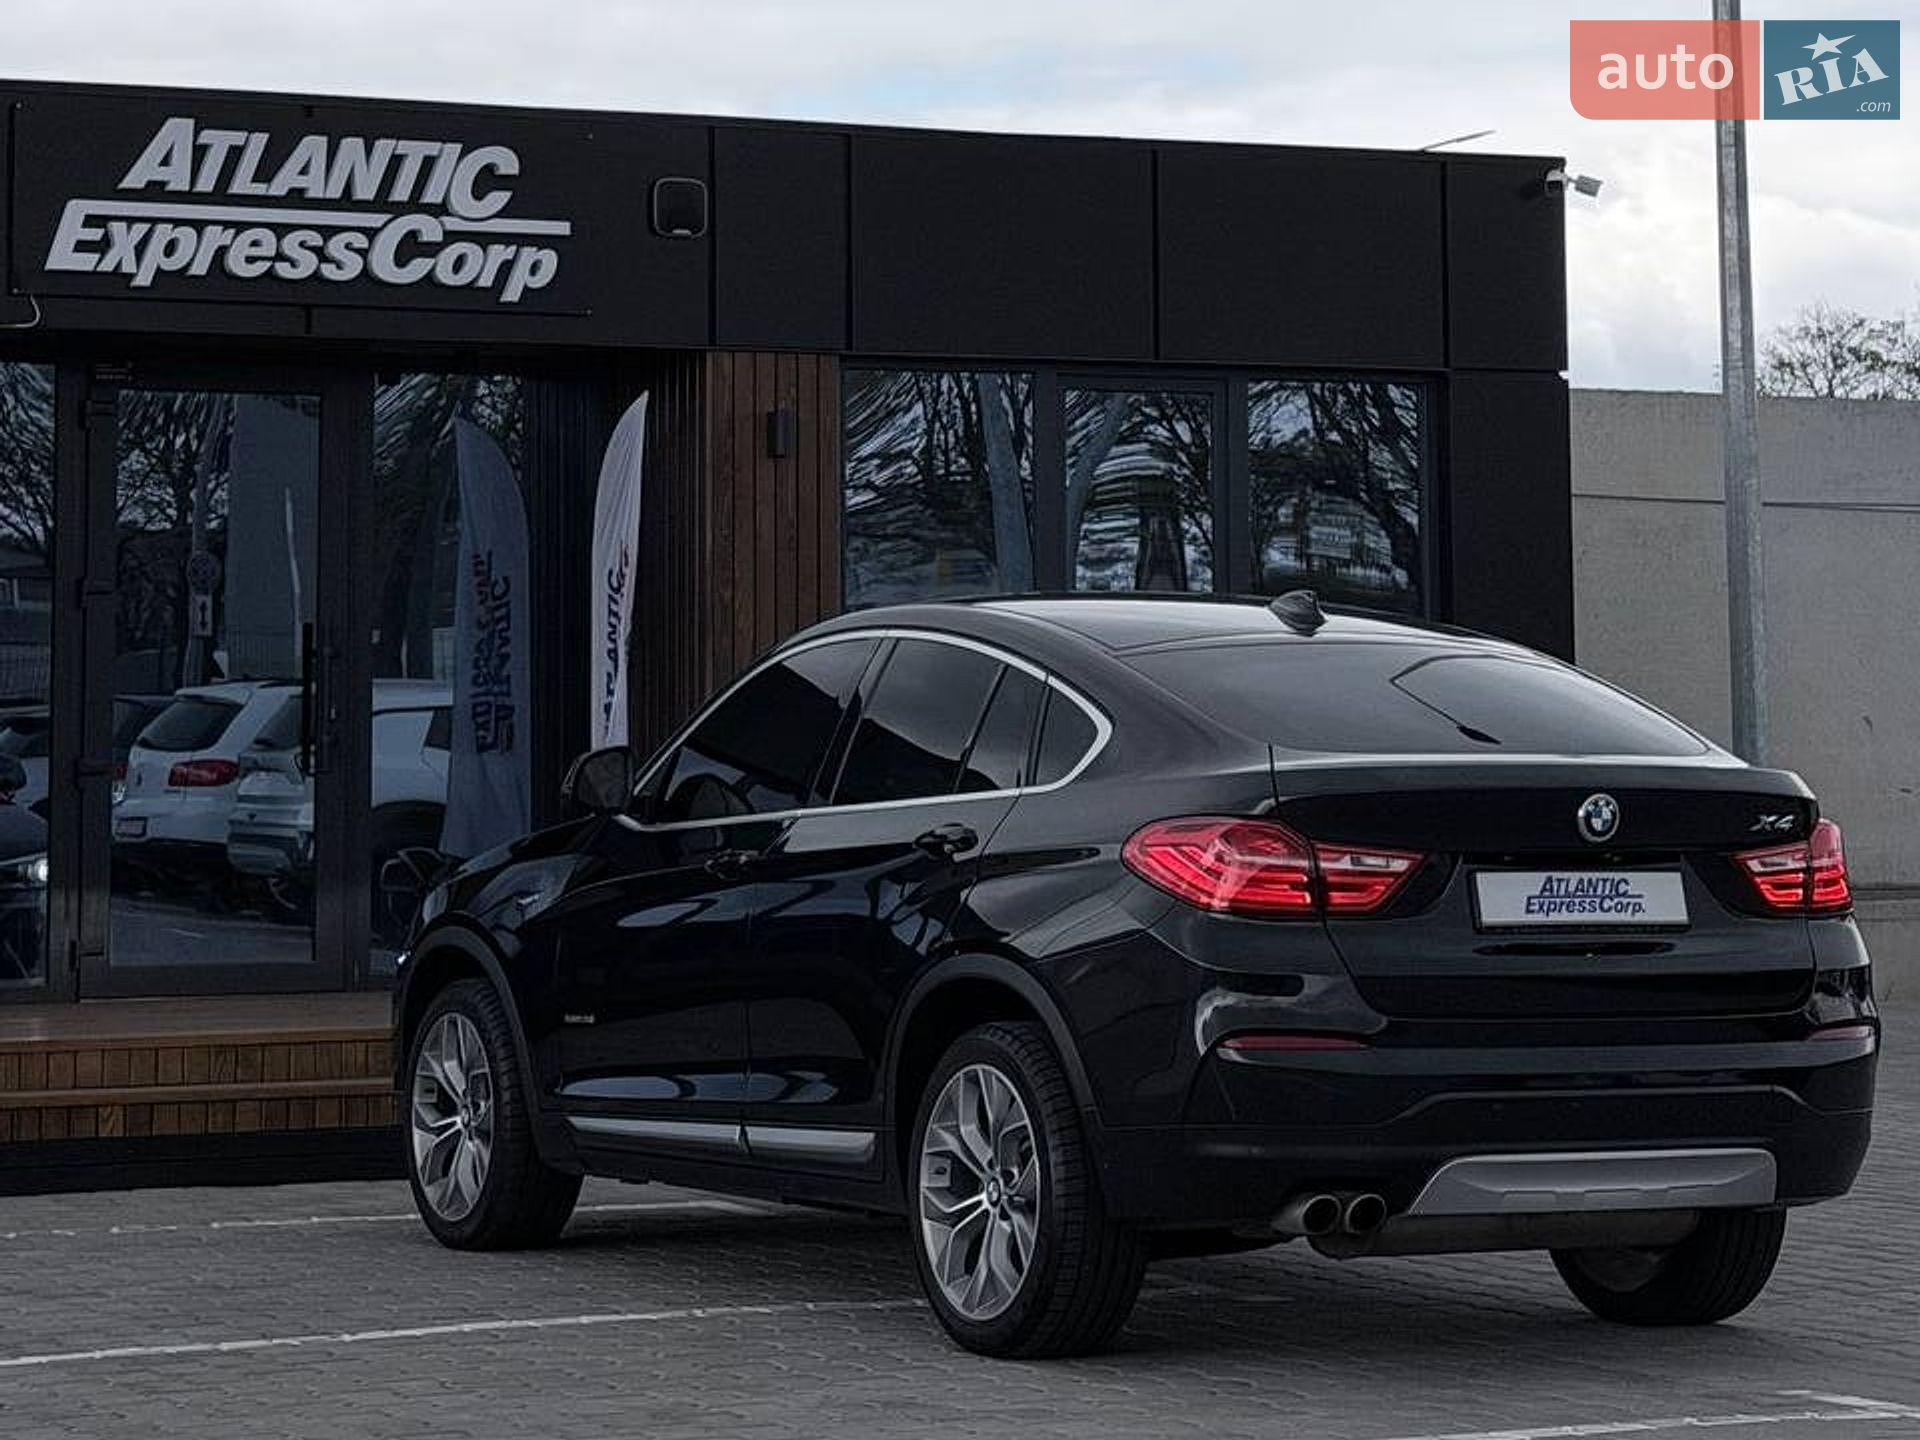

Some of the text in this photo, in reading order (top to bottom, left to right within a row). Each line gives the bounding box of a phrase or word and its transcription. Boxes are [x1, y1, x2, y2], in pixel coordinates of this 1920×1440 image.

[117, 117, 520, 220] ATLANTIC
[43, 199, 559, 303] ExpressCorp
[1750, 814, 1794, 831] X4
[1540, 875, 1630, 897] ATLANTIC
